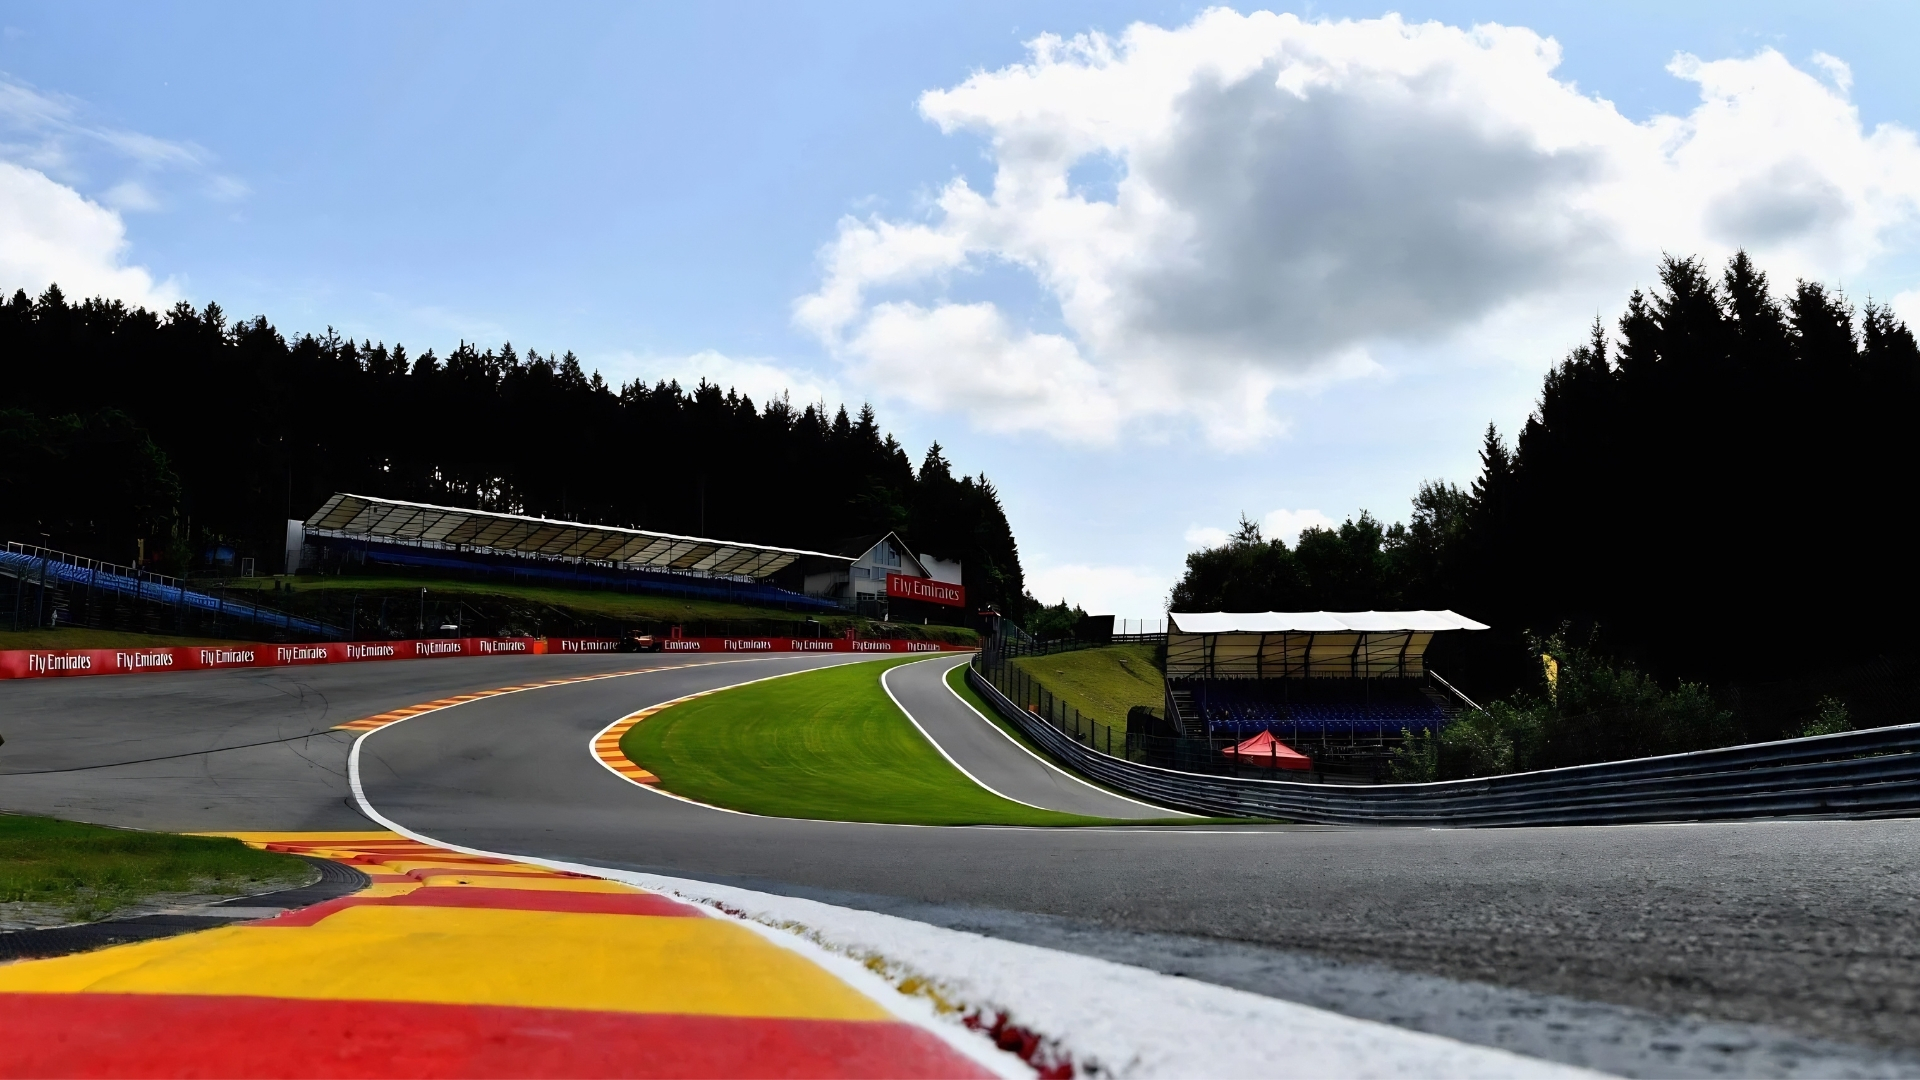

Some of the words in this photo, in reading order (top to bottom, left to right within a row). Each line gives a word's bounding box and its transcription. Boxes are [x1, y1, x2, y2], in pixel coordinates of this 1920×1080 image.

[893, 577, 912, 596] Fly
[914, 580, 960, 601] Emirates
[347, 645, 360, 659] Fly
[361, 644, 394, 657] Emirates
[416, 642, 429, 656] Fly
[480, 640, 492, 653] Fly
[493, 640, 526, 652] Emirates
[562, 640, 578, 652] Fly
[580, 640, 620, 651] Emirate
[664, 640, 700, 650] Emirates
[724, 639, 738, 651] Fly
[117, 653, 133, 671] Fly
[135, 652, 173, 668] Emirates
[201, 650, 214, 666] Fly
[216, 649, 255, 664] Emirates
[277, 647, 291, 663] Fly
[294, 646, 327, 660] Emirates
[29, 654, 46, 674] Fly
[48, 653, 91, 670] Emirates
